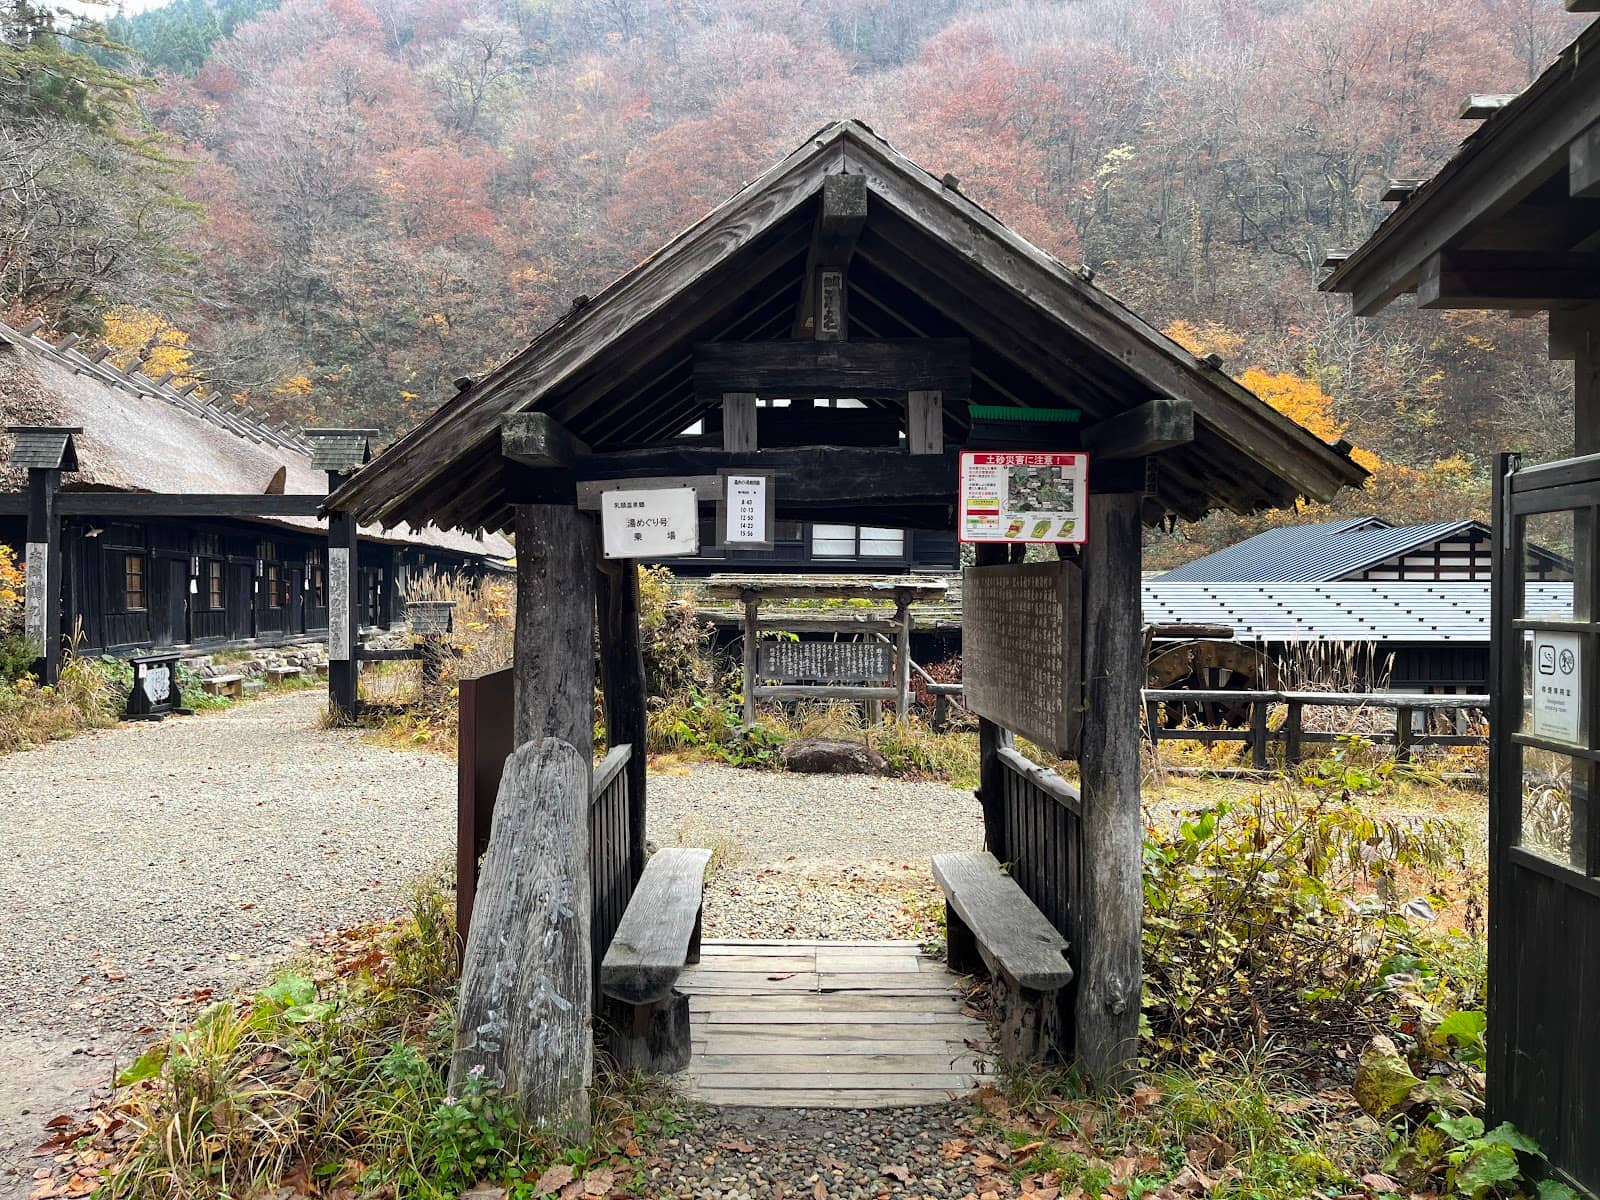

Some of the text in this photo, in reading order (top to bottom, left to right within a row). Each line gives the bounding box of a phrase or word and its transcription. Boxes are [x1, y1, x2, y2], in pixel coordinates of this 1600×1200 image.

[627, 517, 668, 528] 湯めぐり号
